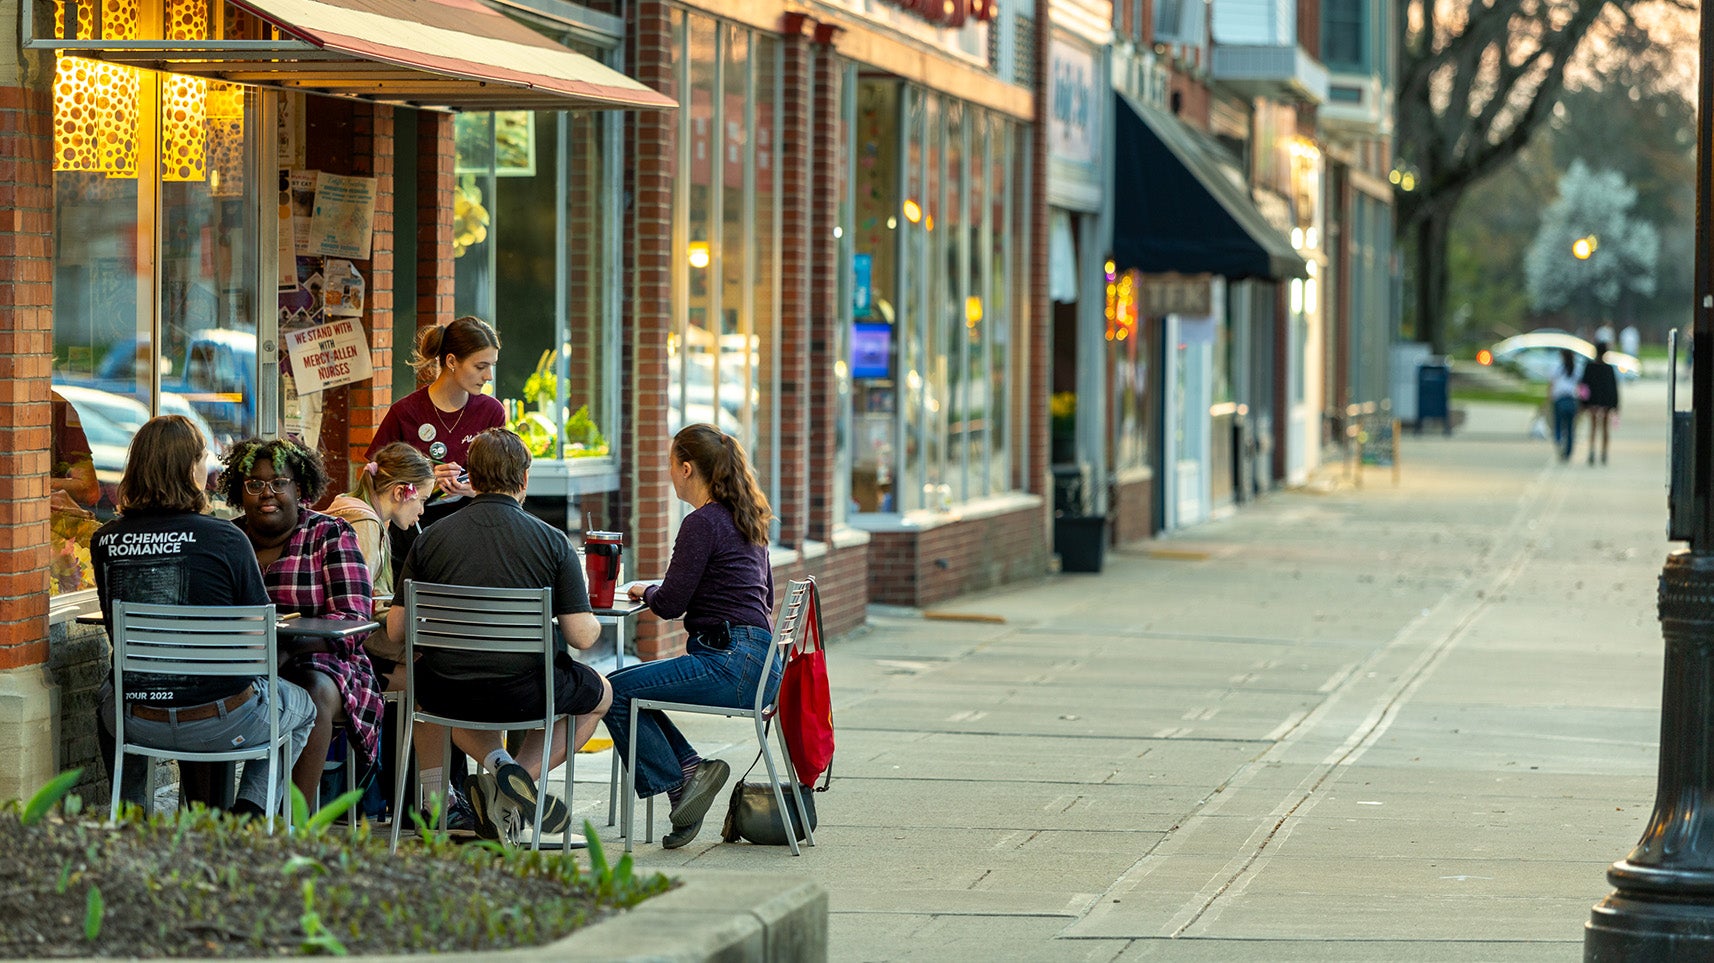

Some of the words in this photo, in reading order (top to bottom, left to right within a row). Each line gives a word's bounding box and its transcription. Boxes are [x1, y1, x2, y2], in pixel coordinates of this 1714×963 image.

[294, 333, 307, 345] WE
[307, 325, 333, 342] STAND
[333, 321, 353, 336] WITH
[318, 339, 336, 351] WITH
[303, 345, 358, 369] MERCY-ALLEN
[317, 362, 351, 381] NURSES
[98, 533, 119, 547] MY
[122, 531, 197, 544] CHEMICAL
[108, 542, 182, 557] ROMANCE
[125, 692, 147, 701] TOUR
[150, 691, 174, 701] 2022
